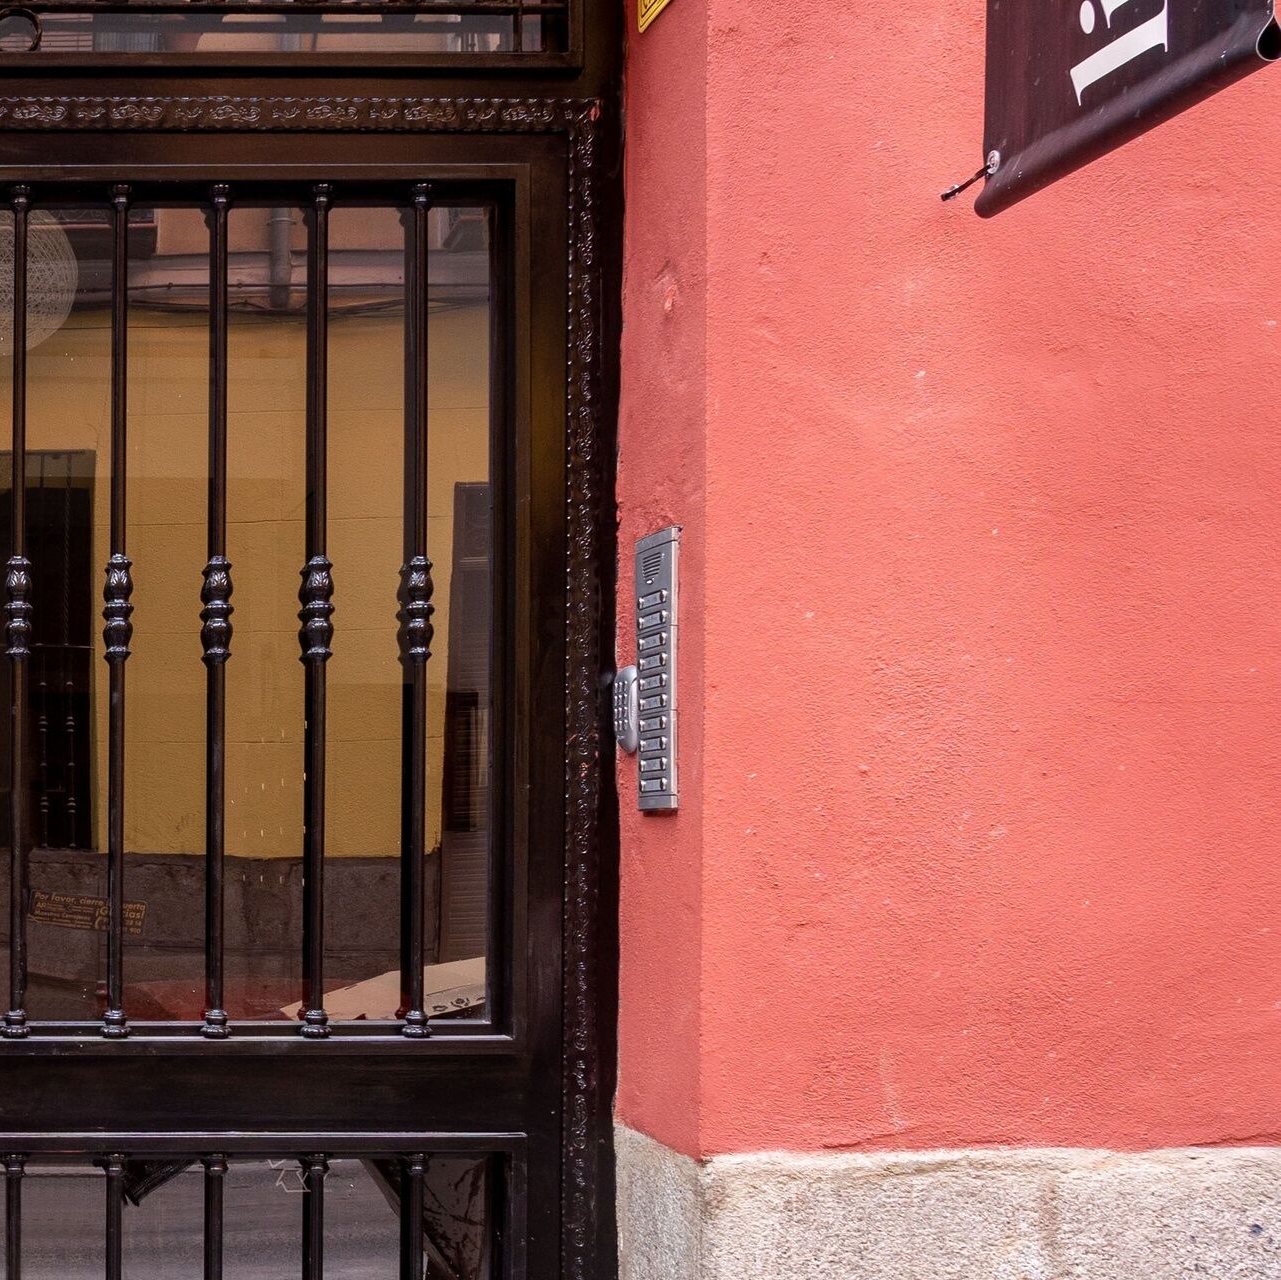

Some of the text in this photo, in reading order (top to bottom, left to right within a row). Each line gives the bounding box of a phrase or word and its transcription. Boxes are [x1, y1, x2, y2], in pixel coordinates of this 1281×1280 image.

[34, 891, 49, 900] Por
[51, 892, 76, 904] favor,
[79, 897, 104, 906] cierre
